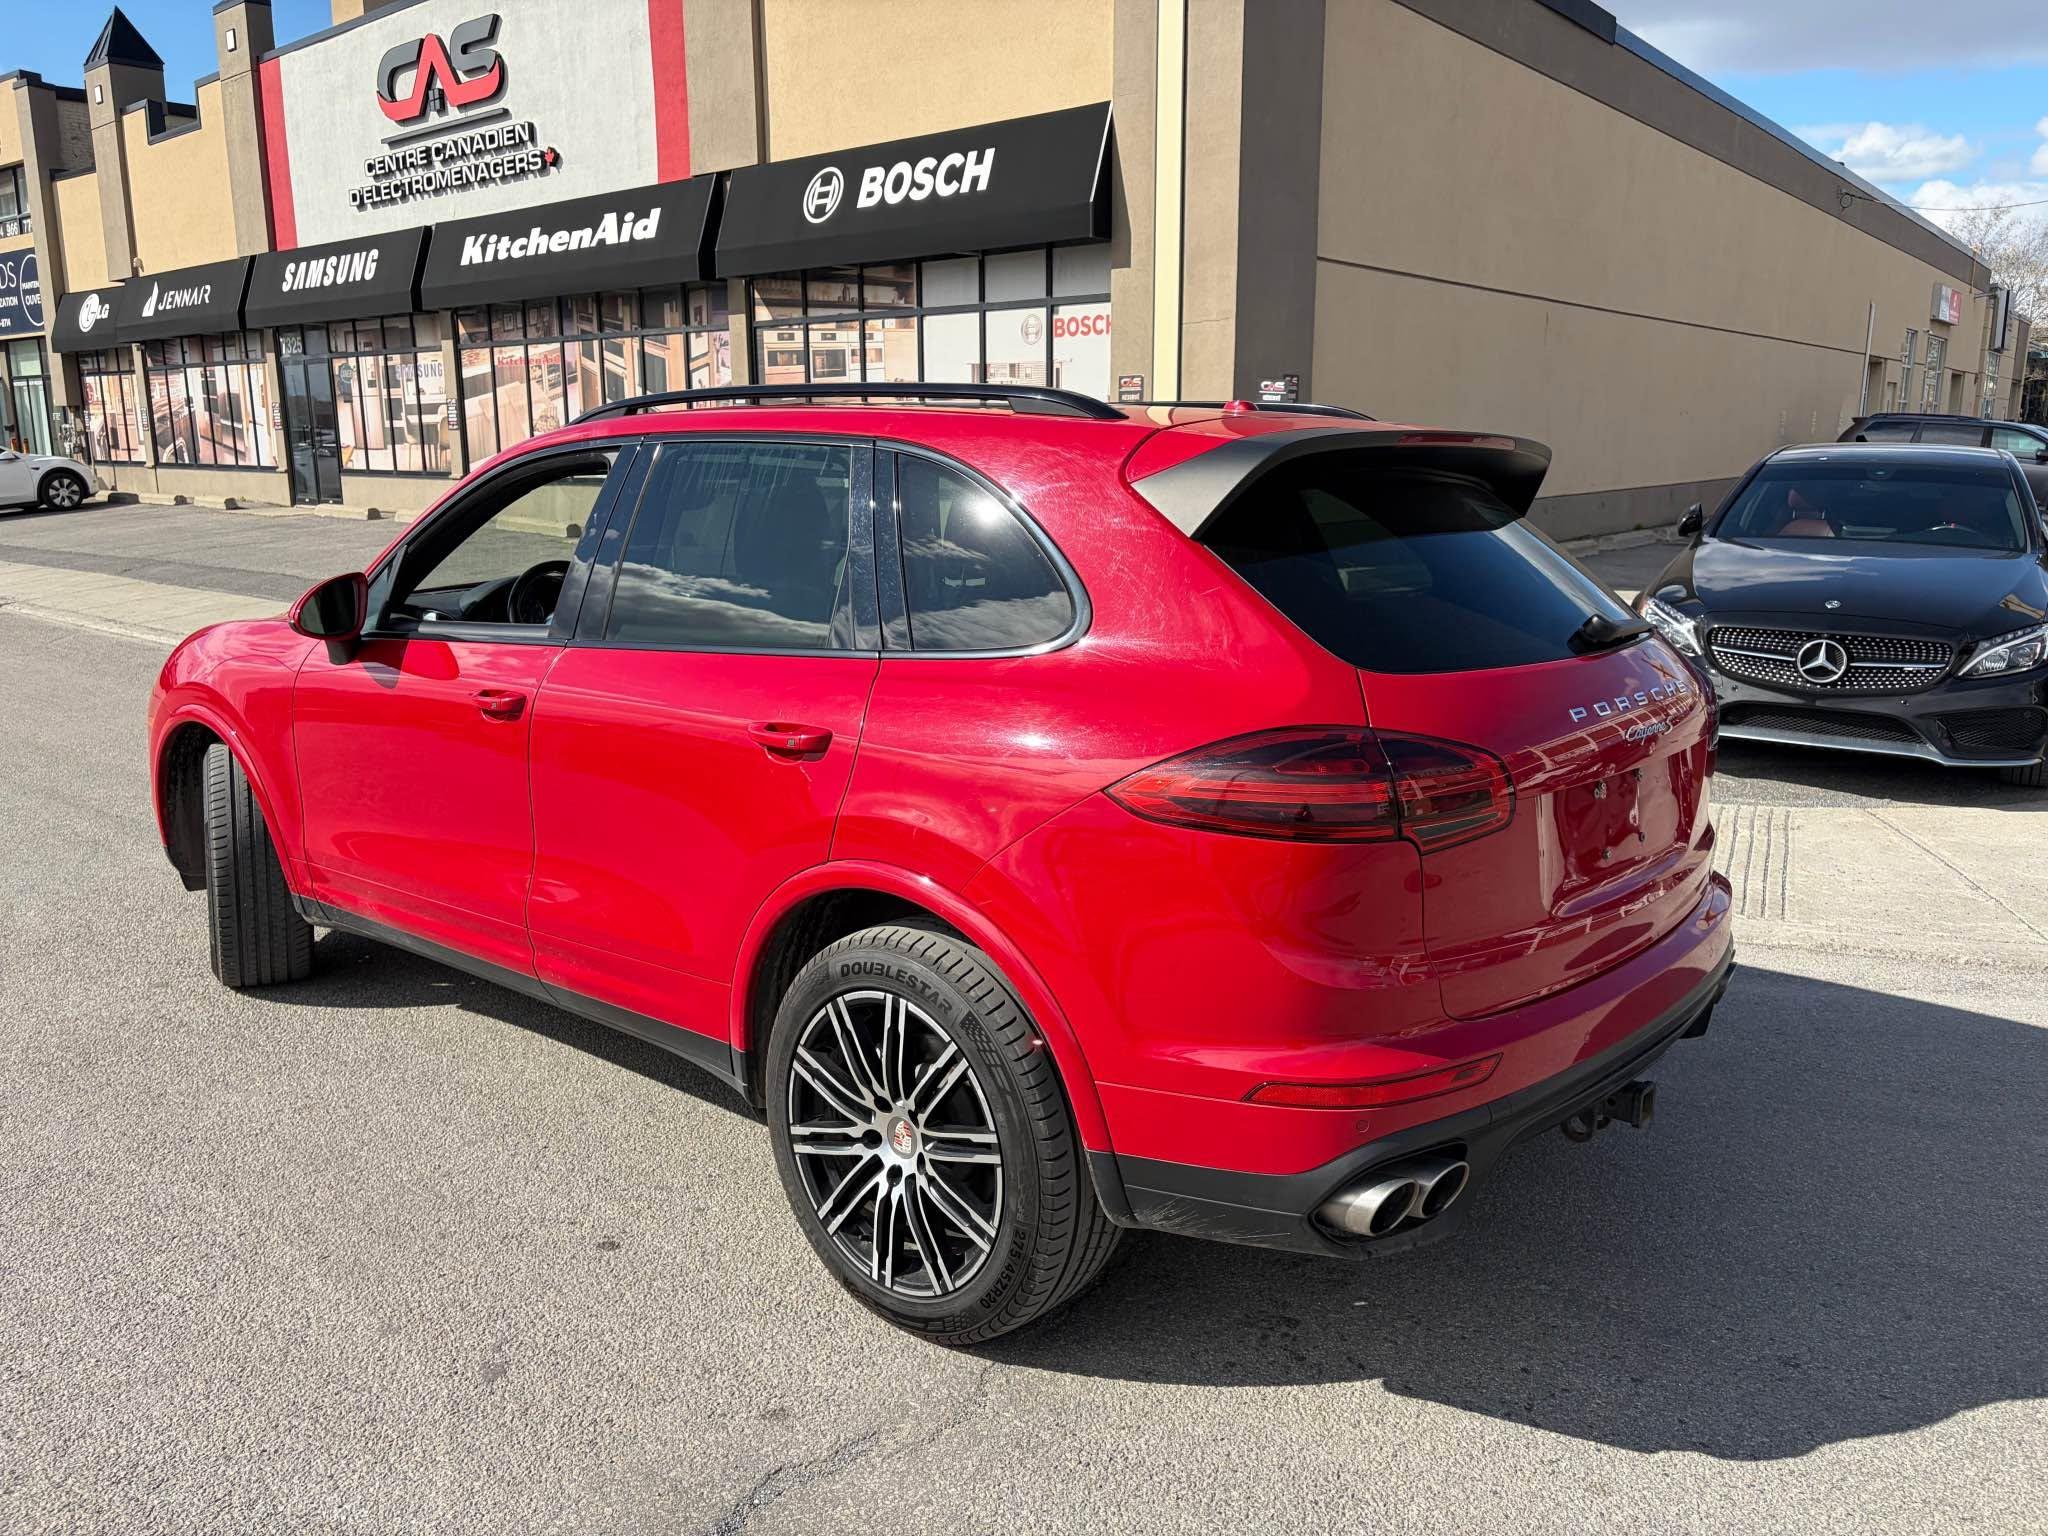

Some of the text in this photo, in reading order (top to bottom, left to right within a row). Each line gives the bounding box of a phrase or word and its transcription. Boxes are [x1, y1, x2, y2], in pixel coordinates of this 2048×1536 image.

[377, 14, 503, 121] CAS
[364, 121, 531, 177] CENTRE CANADIEN
[349, 150, 543, 207] D'ELECTROMENAGERS
[857, 147, 996, 208] BOSCH
[460, 208, 662, 266] KitchenAid
[158, 285, 211, 311] JENNAIR
[282, 249, 379, 292] SAMSUNG
[96, 303, 110, 319] LG
[1568, 680, 1688, 722] PORSCHE
[840, 961, 953, 1016] DOUBLESTAR
